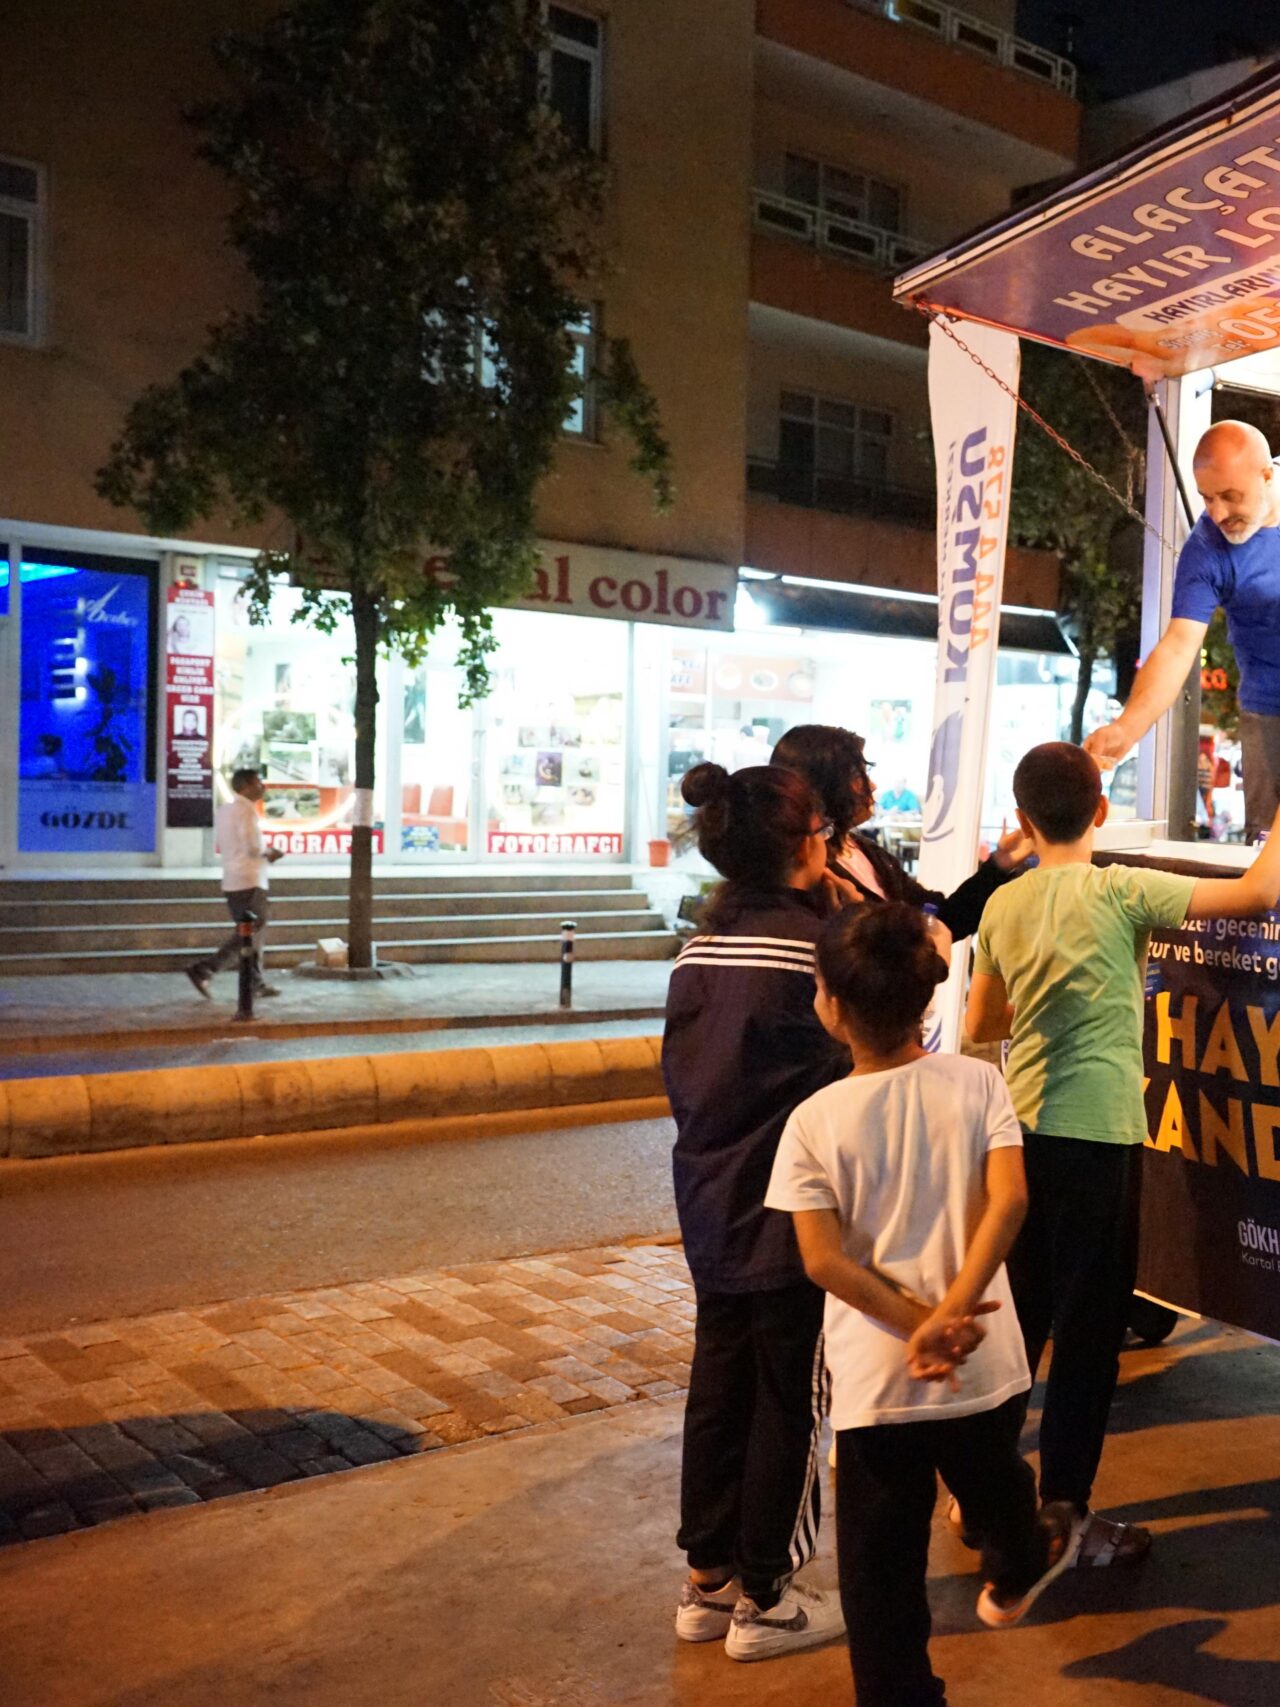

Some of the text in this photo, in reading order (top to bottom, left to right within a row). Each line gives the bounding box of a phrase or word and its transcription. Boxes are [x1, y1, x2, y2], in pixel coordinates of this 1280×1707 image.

[1052, 245, 1232, 314] HAYIR
[587, 566, 728, 621] color
[1173, 944, 1191, 962] ve
[1194, 940, 1262, 973] bereket
[1241, 1251, 1275, 1270] Kartal
